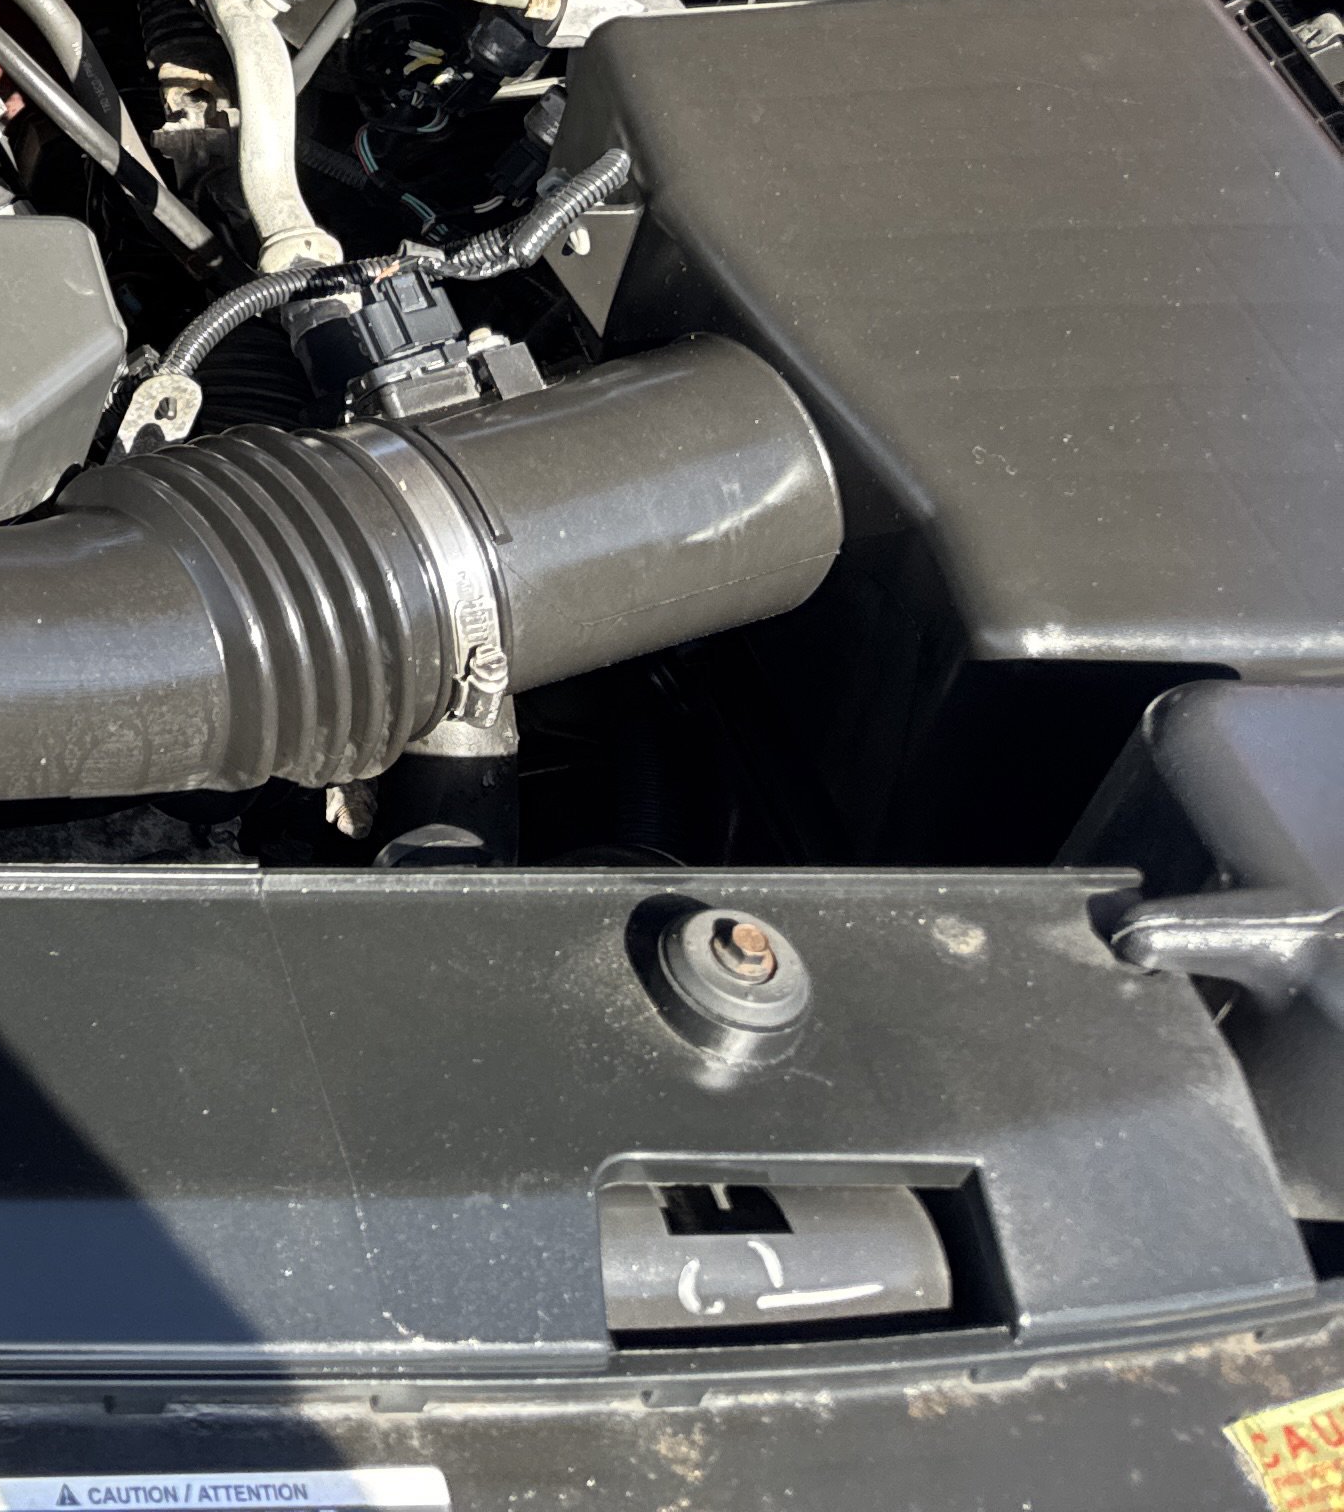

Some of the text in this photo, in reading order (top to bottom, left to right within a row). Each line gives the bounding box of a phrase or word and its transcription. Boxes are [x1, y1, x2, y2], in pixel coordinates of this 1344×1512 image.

[1250, 1405, 1344, 1469] CAU
[88, 1483, 308, 1505] CAUTION / ATTENTION
